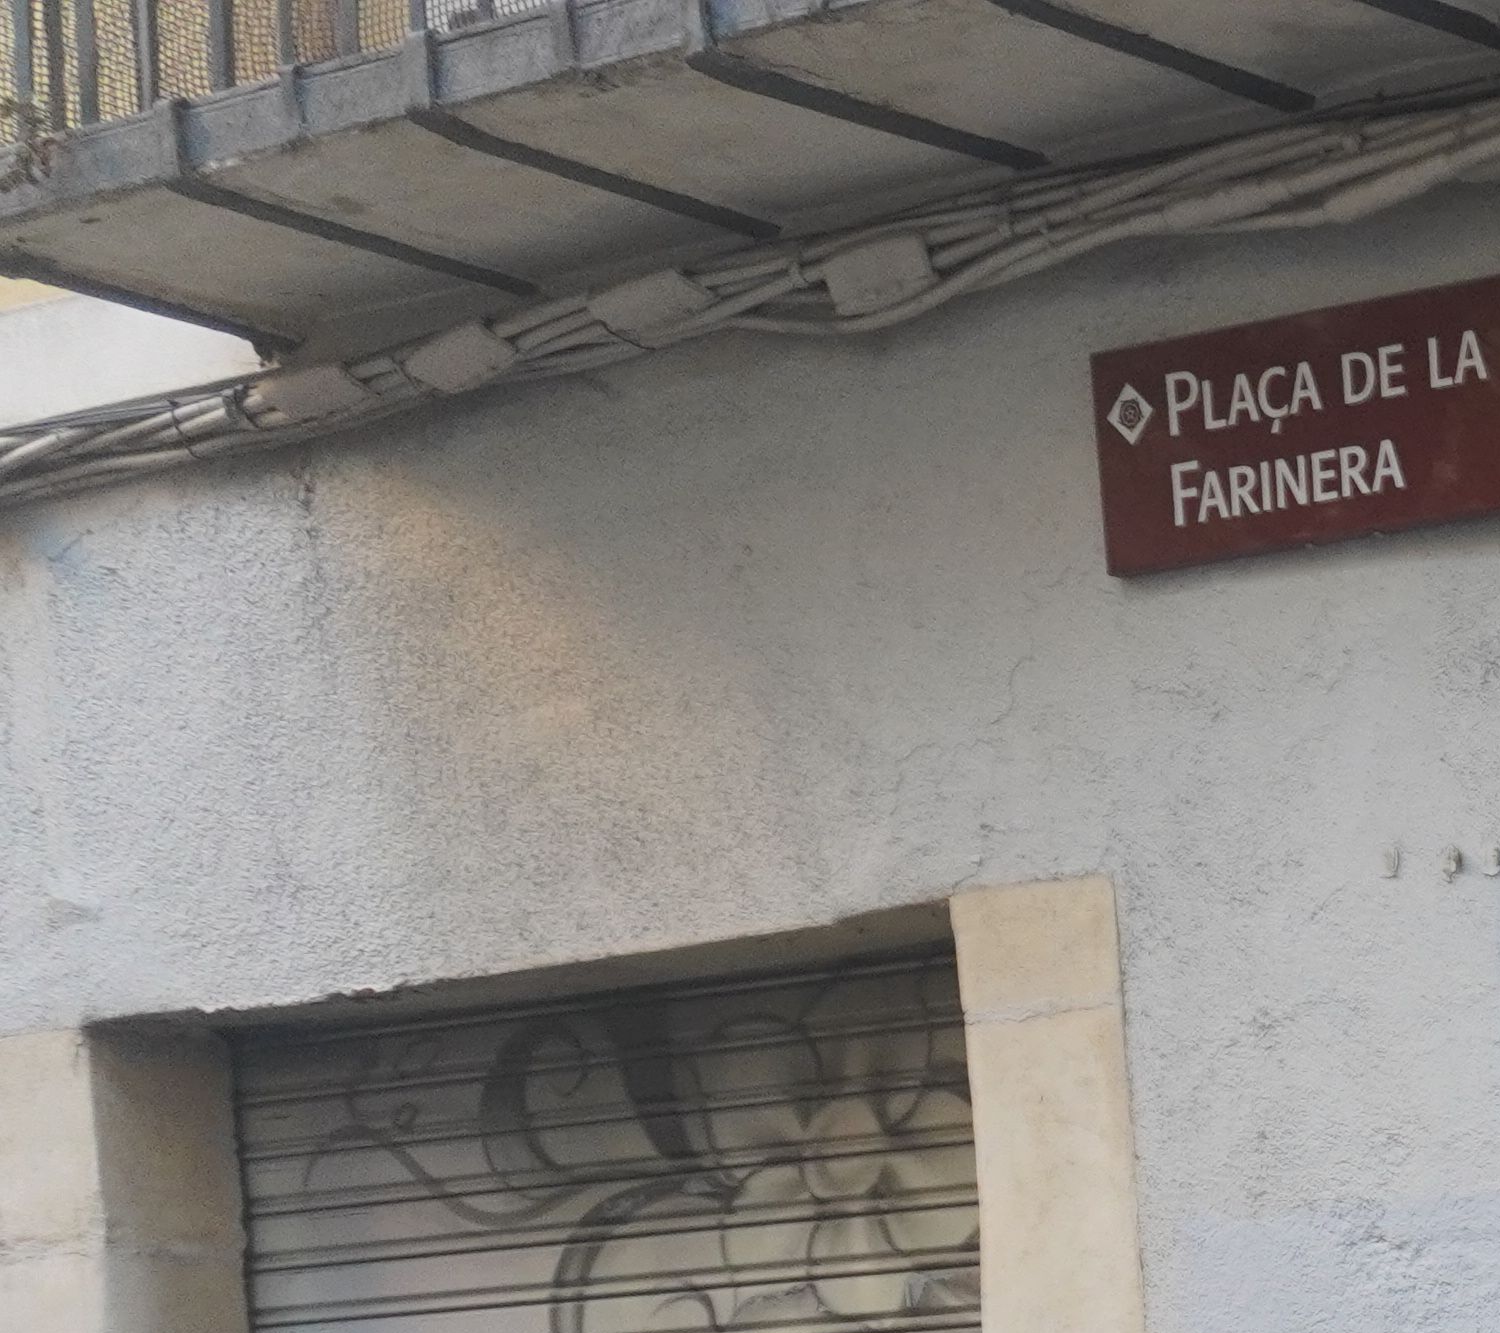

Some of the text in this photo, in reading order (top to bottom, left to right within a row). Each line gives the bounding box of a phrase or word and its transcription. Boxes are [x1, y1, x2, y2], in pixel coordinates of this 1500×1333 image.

[1165, 329, 1488, 437] PLAÇA DE LA
[1171, 439, 1407, 528] FARINERA
